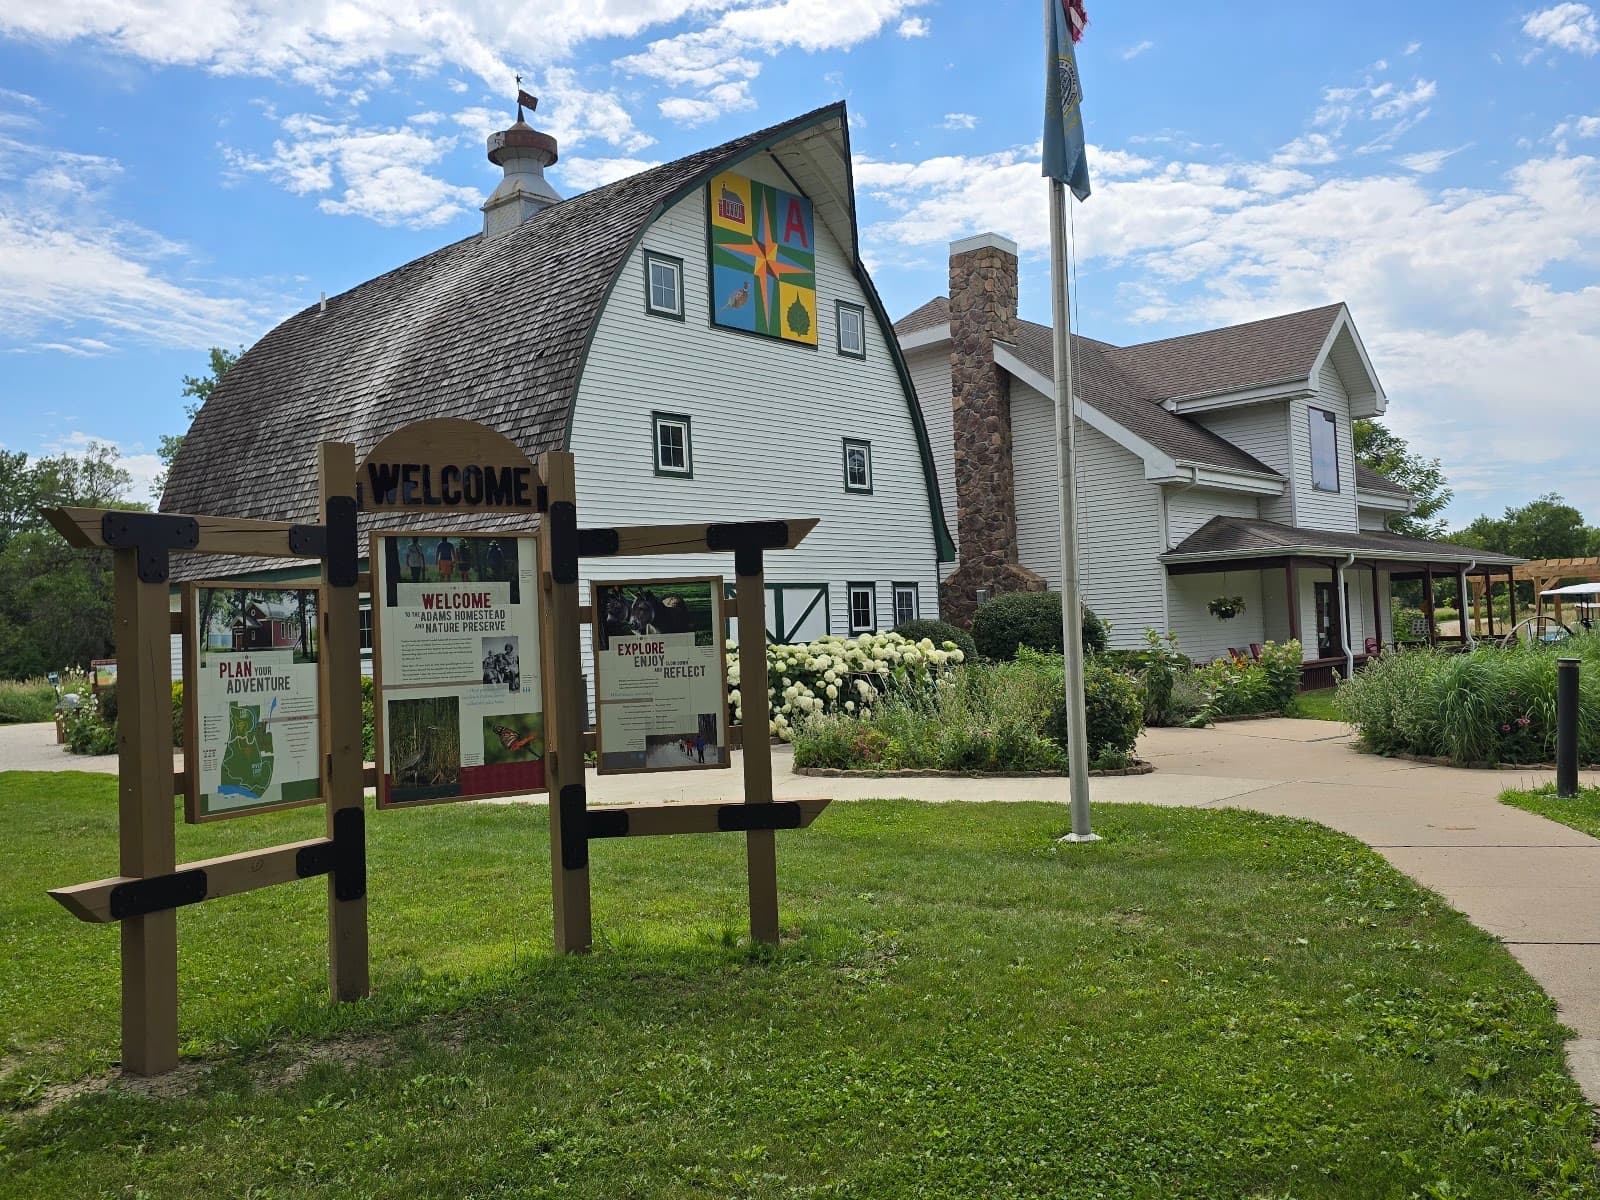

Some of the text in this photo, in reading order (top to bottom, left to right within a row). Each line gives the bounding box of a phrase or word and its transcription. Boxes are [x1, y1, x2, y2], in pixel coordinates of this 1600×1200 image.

[784, 197, 808, 249] A
[367, 463, 532, 506] WELCOME
[422, 592, 491, 610] WELCOME
[421, 610, 451, 621] ADAMS
[455, 609, 506, 620] HOMESTEAD
[425, 622, 460, 633] NATURE
[463, 620, 506, 632] PRESERVE
[618, 642, 664, 655] EXPLORE
[219, 660, 272, 678] PLAN YOUR
[634, 655, 665, 668] ENJOY
[664, 665, 705, 678] REFLECT
[226, 676, 291, 694] ADVENTURE
